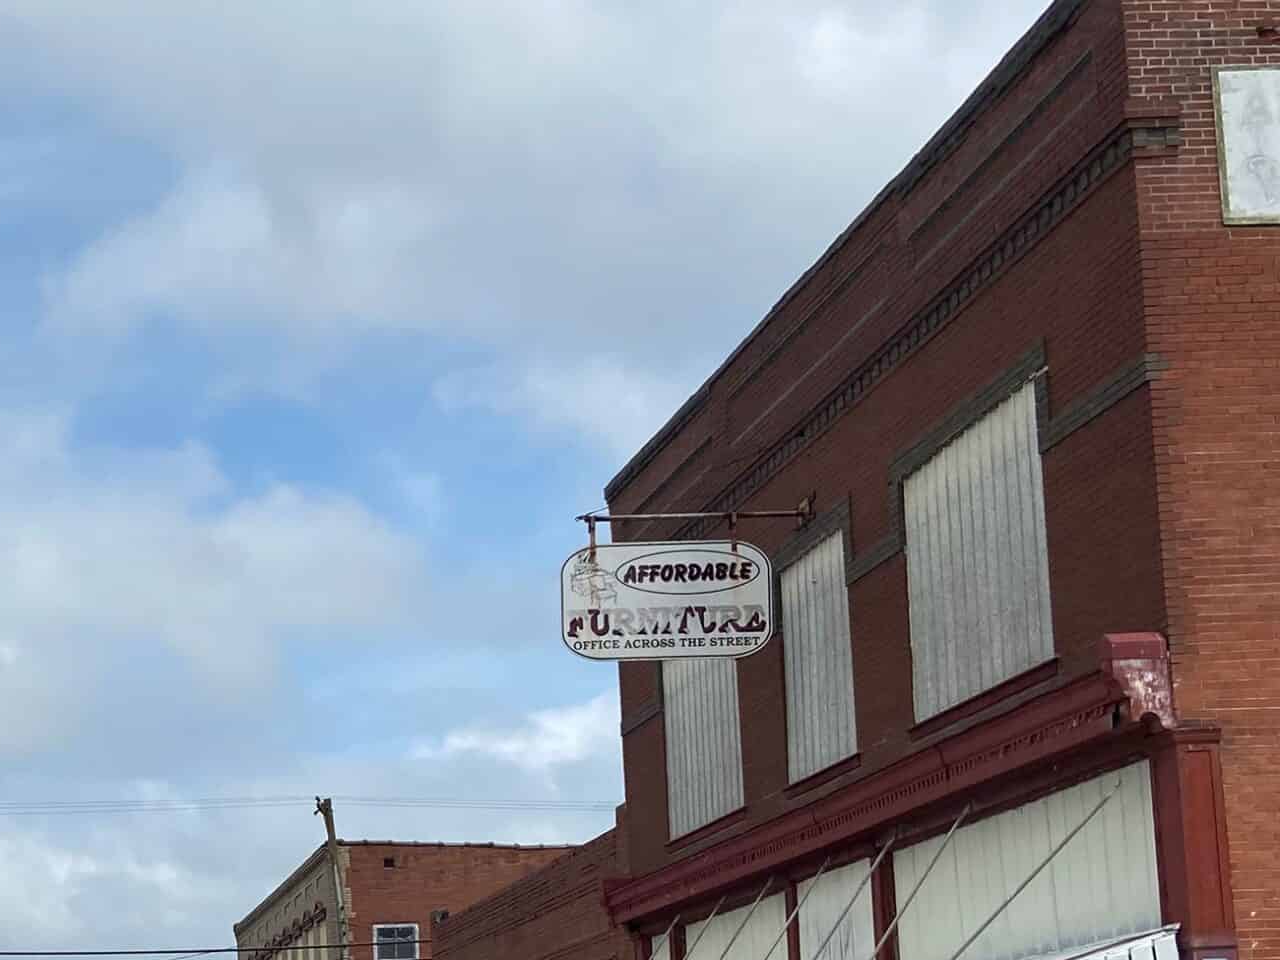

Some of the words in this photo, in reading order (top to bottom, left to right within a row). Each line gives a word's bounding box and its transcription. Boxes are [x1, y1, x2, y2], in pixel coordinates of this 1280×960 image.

[623, 562, 753, 584] AFFORDABLE
[573, 639, 620, 651] OFFICE
[624, 638, 676, 649] ACROSS
[680, 637, 706, 648] THE
[709, 636, 761, 648] STREET
